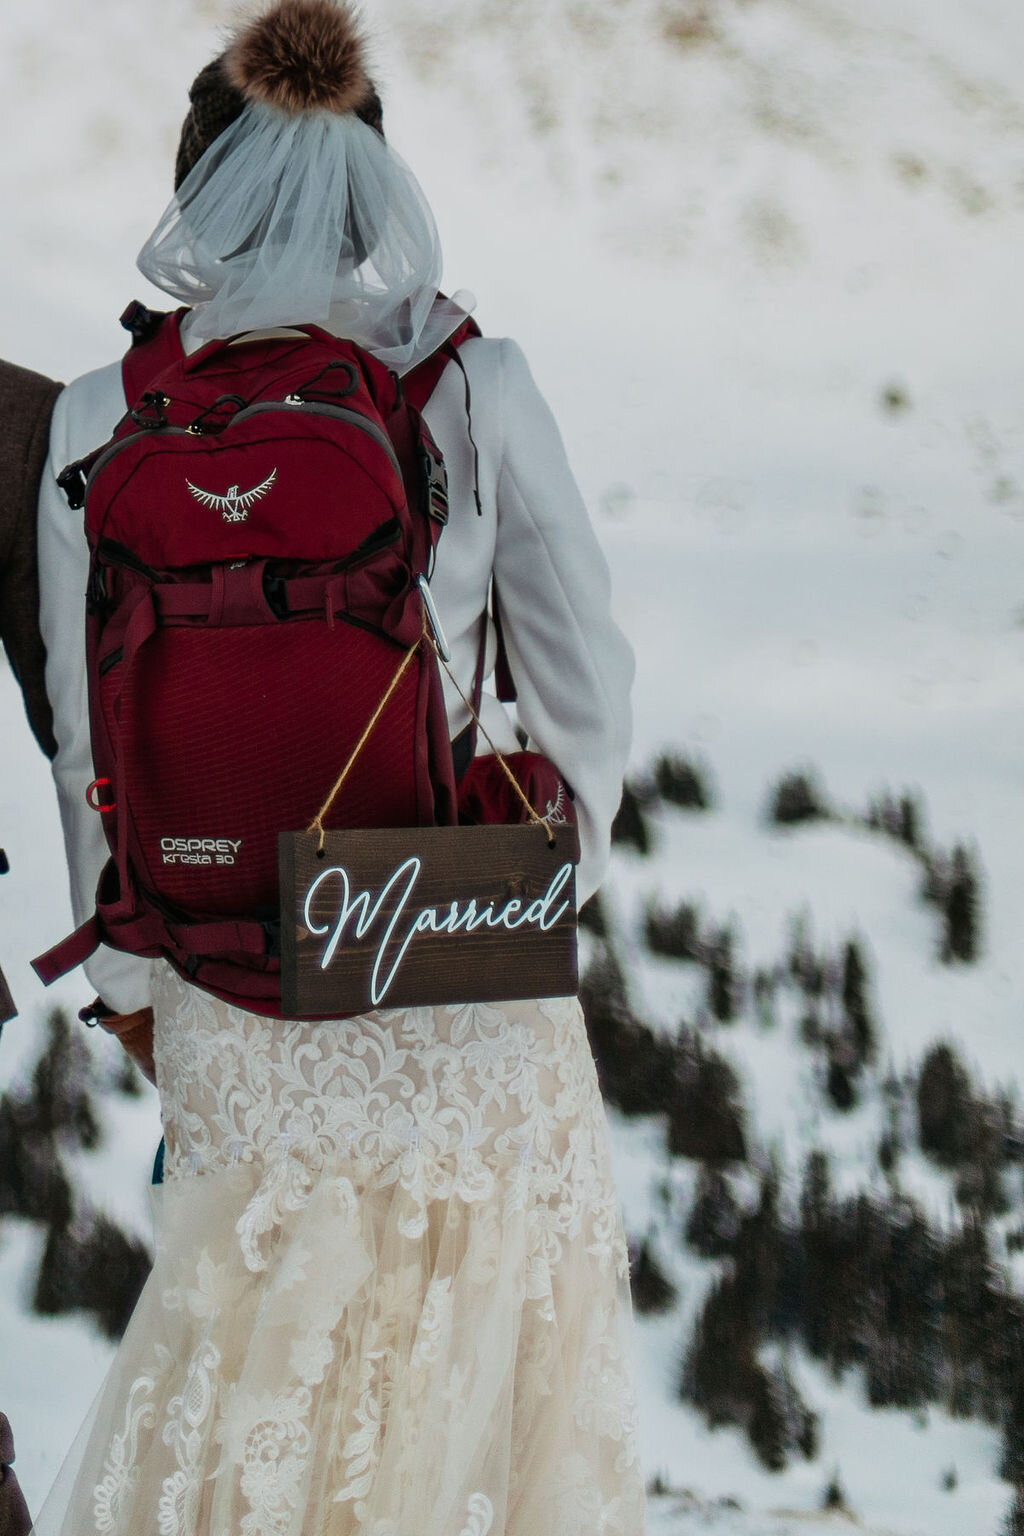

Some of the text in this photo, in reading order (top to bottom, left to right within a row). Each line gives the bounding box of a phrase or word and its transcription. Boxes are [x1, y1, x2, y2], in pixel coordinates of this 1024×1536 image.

[160, 837, 242, 853] OSPREY
[215, 854, 235, 865] 30
[304, 856, 573, 1006] Married
